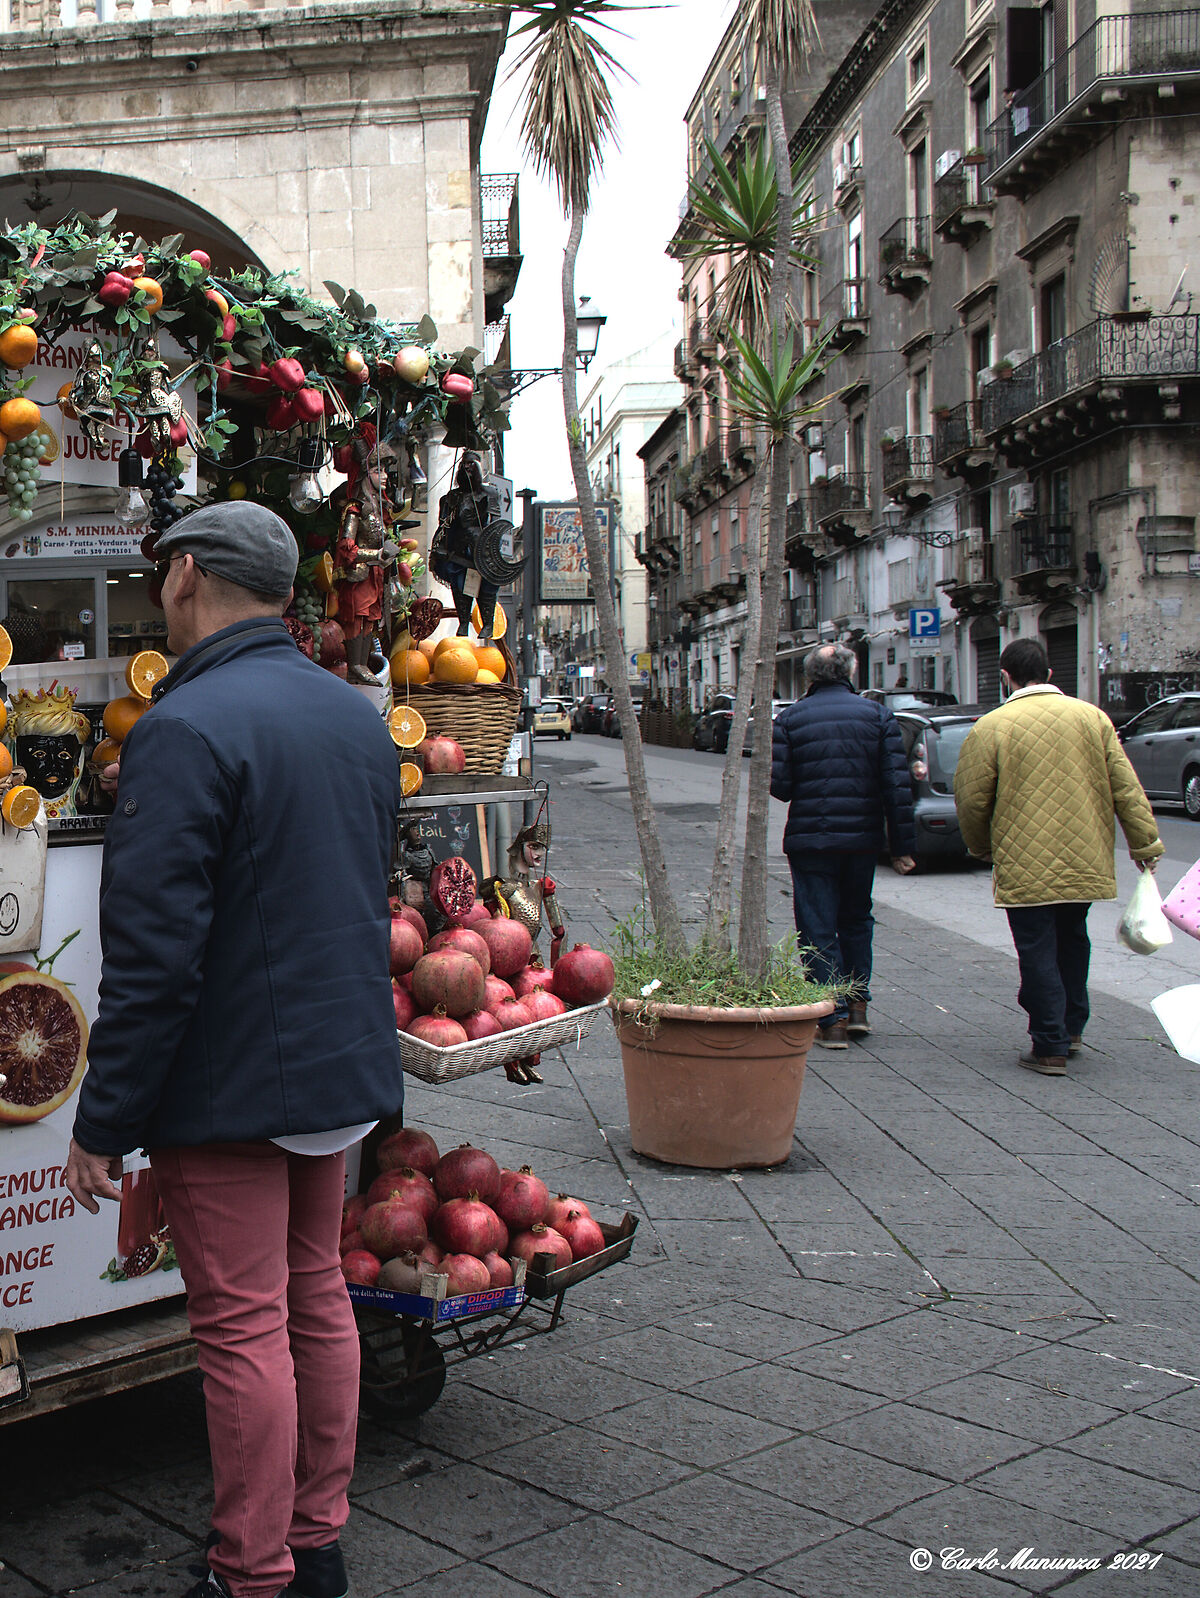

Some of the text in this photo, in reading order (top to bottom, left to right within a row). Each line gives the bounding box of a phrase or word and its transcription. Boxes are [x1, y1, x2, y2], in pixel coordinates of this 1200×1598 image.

[75, 525, 154, 536] MINIMARKE
[915, 610, 935, 635] P
[467, 1290, 506, 1304] DIPODI
